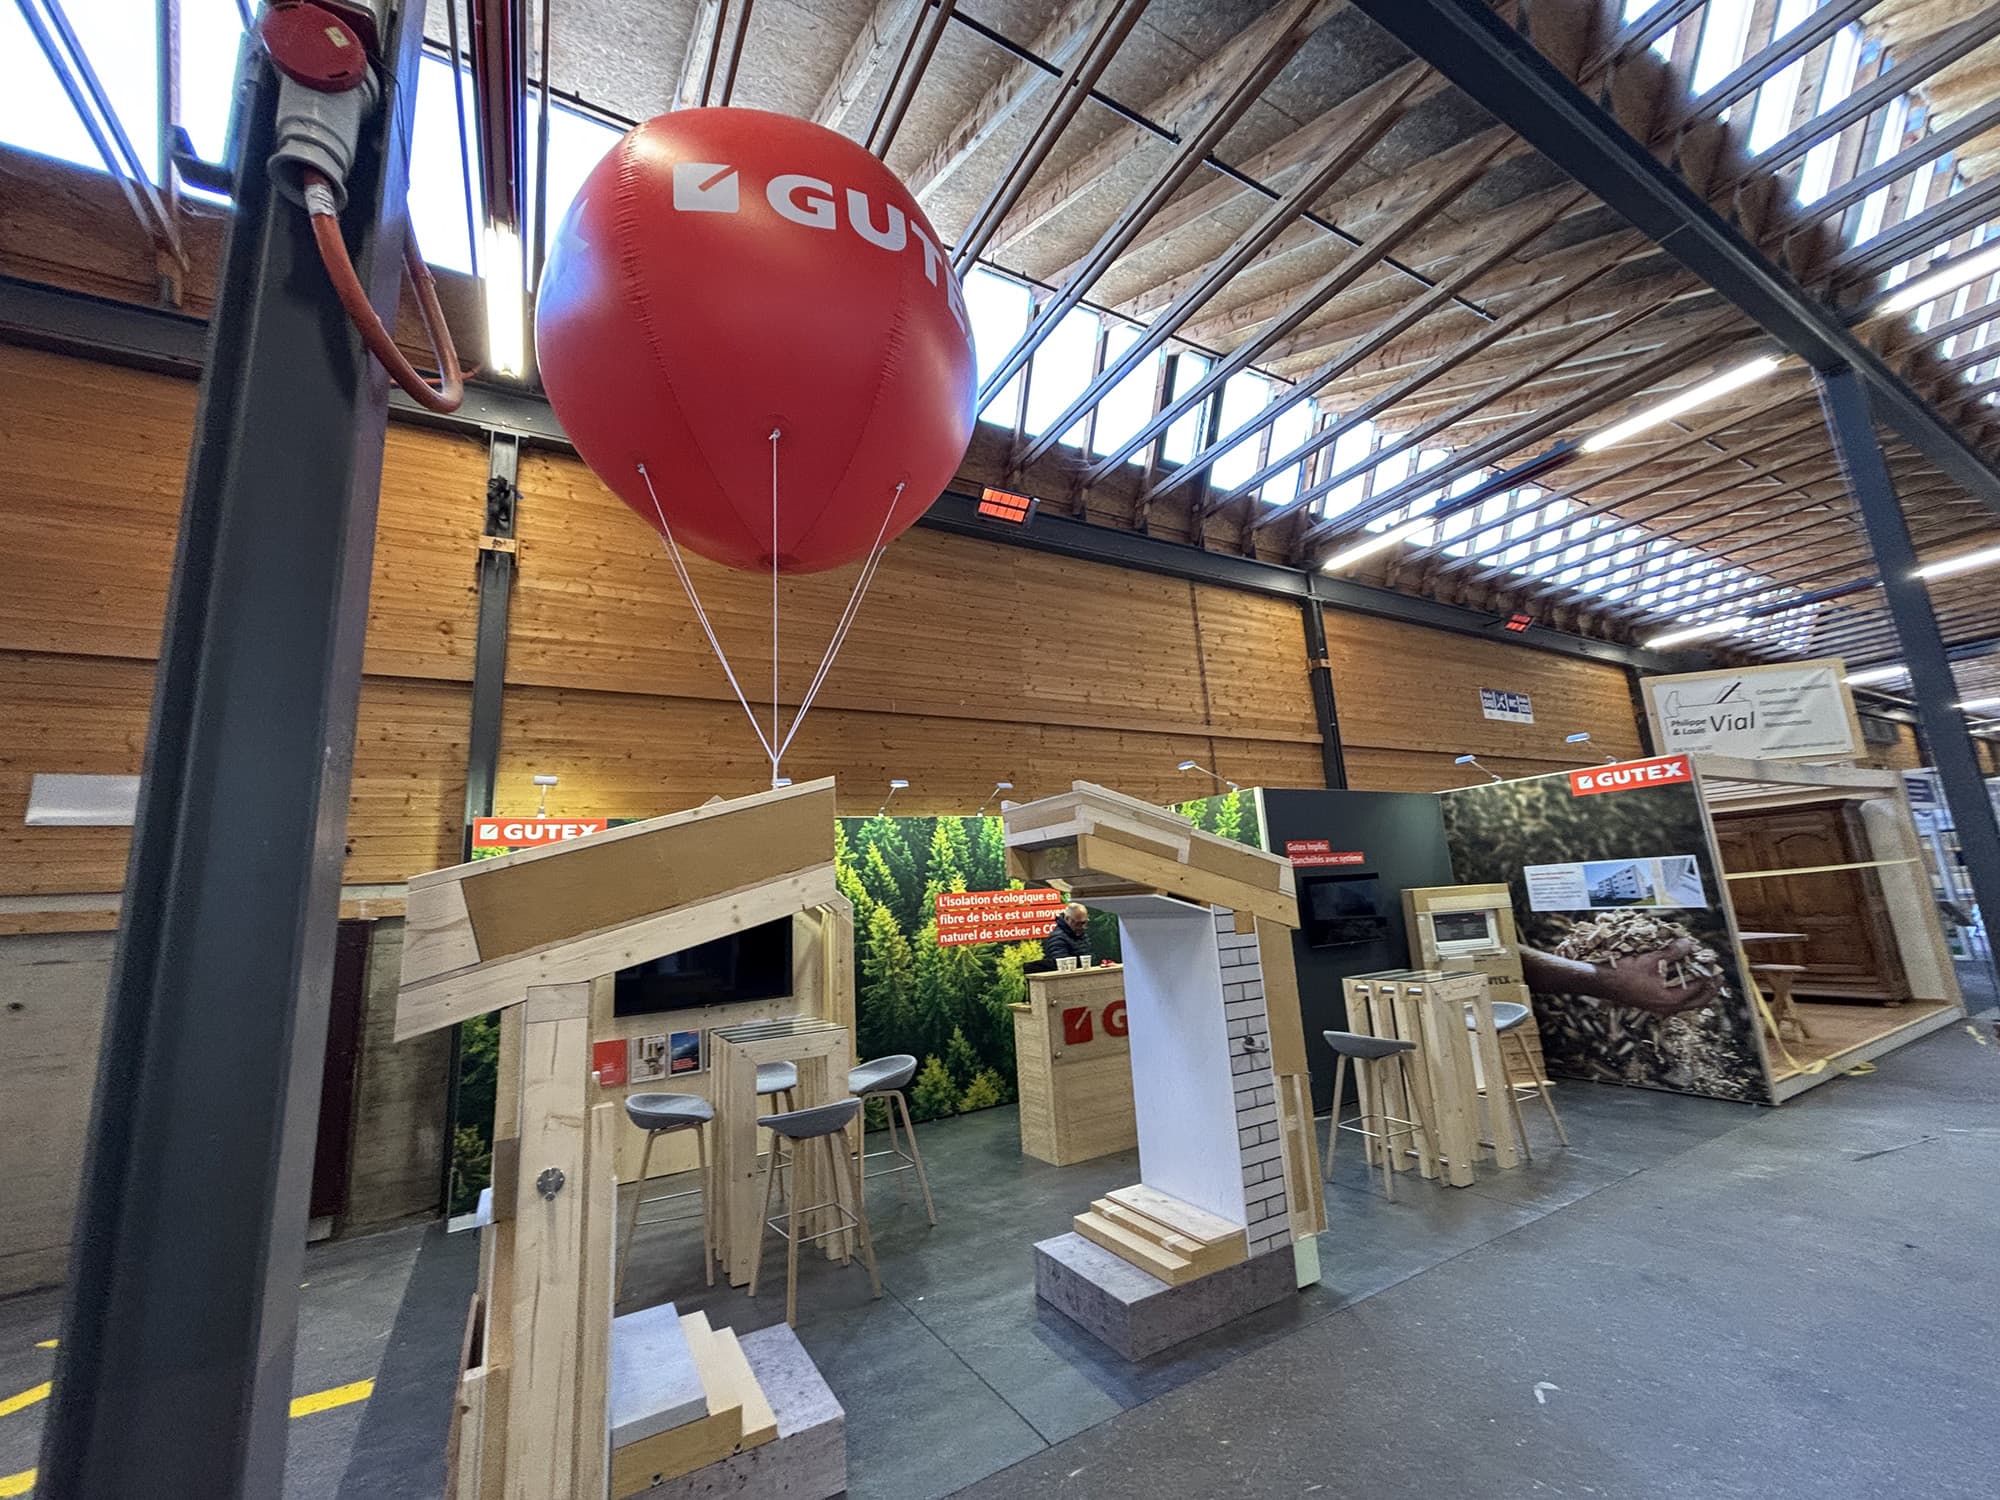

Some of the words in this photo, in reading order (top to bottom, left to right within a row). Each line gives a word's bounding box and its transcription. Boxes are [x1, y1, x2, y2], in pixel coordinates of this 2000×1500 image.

[766, 174, 974, 352] GUTE
[1710, 711, 1754, 732] Vial
[1596, 762, 1684, 787] GUTEX
[503, 823, 598, 840] GUTEX
[939, 894, 991, 907] L'isolation
[993, 892, 1044, 905] écologique
[1046, 893, 1058, 901] en
[940, 913, 965, 925] fibre
[967, 912, 980, 922] de
[982, 910, 1003, 921] bois
[1004, 910, 1020, 920] est
[1022, 911, 1034, 919] un
[940, 929, 977, 943] naturel
[980, 929, 993, 939] de
[994, 926, 1030, 938] stocker
[1032, 925, 1041, 935] le
